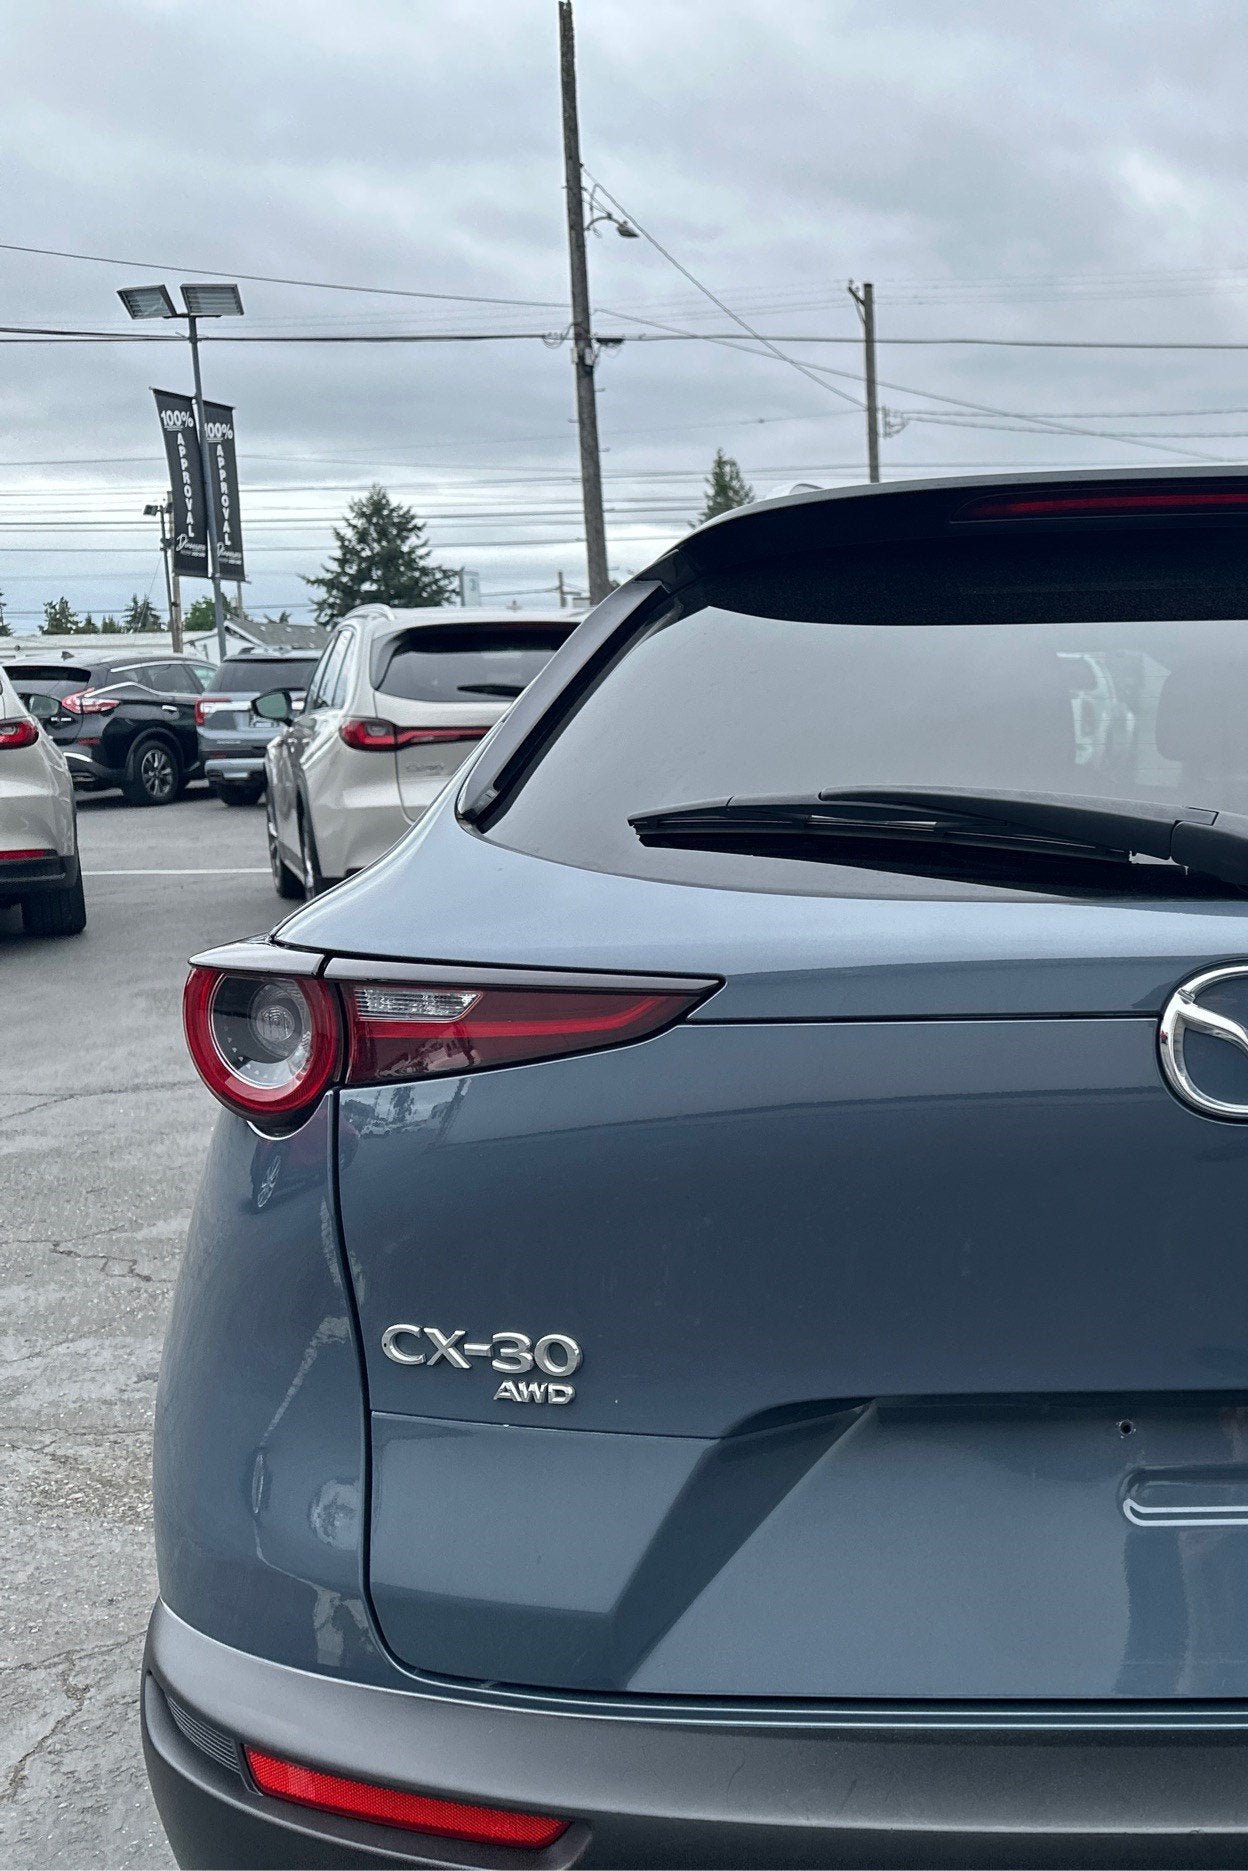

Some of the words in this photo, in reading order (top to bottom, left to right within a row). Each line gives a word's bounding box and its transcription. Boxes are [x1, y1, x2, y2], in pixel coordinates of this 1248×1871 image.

[161, 409, 194, 428] 100%
[177, 432, 194, 538] APPROVAL
[216, 444, 231, 546] APPROVAL
[381, 1323, 584, 1377] CX-30
[493, 1380, 576, 1405] AWD
